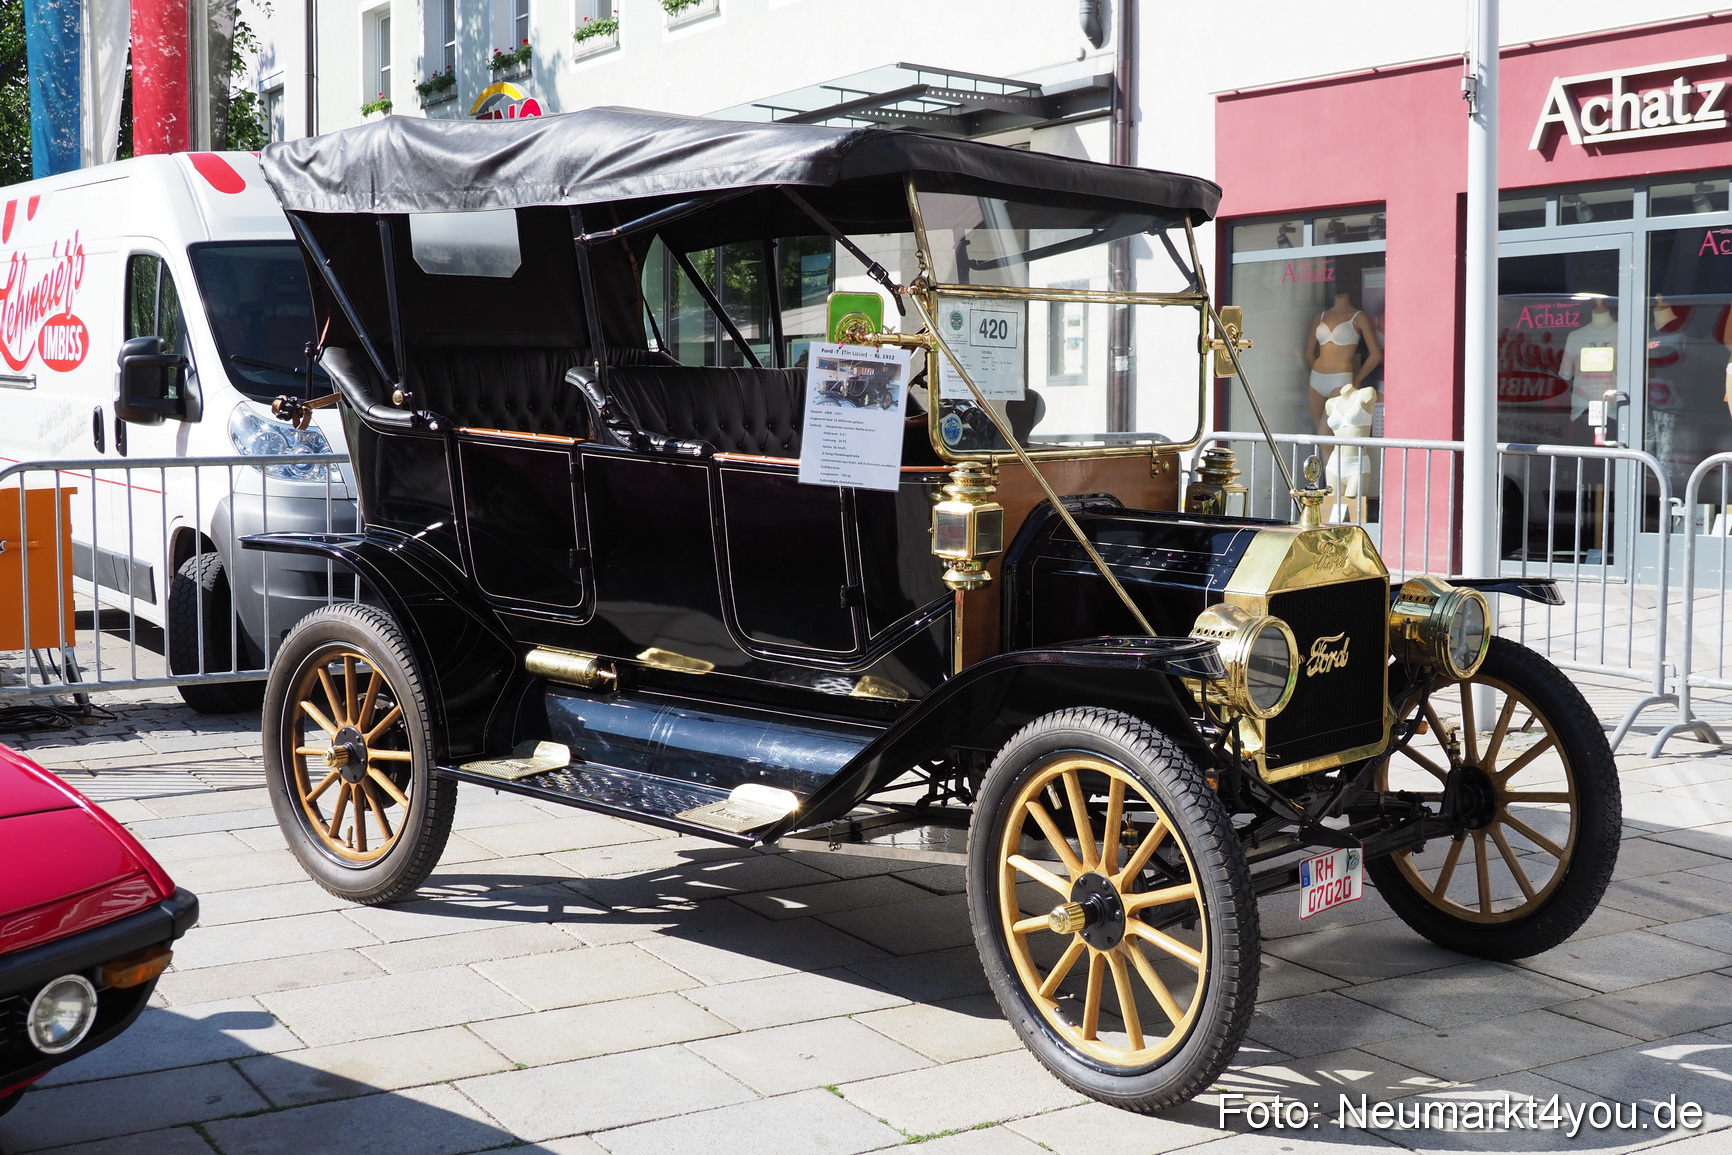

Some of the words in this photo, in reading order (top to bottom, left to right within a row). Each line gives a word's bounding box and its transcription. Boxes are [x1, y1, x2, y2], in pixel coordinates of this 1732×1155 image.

[1528, 72, 1727, 150] Achatz
[1282, 263, 1335, 283] Achatz
[979, 318, 1008, 340] 420
[1516, 305, 1581, 328] Achatz
[43, 325, 83, 362] IMBISS
[852, 350, 868, 358] Lizzie)
[1306, 631, 1351, 677] Ford
[1316, 856, 1334, 883] RH
[1308, 875, 1352, 913] 07020
